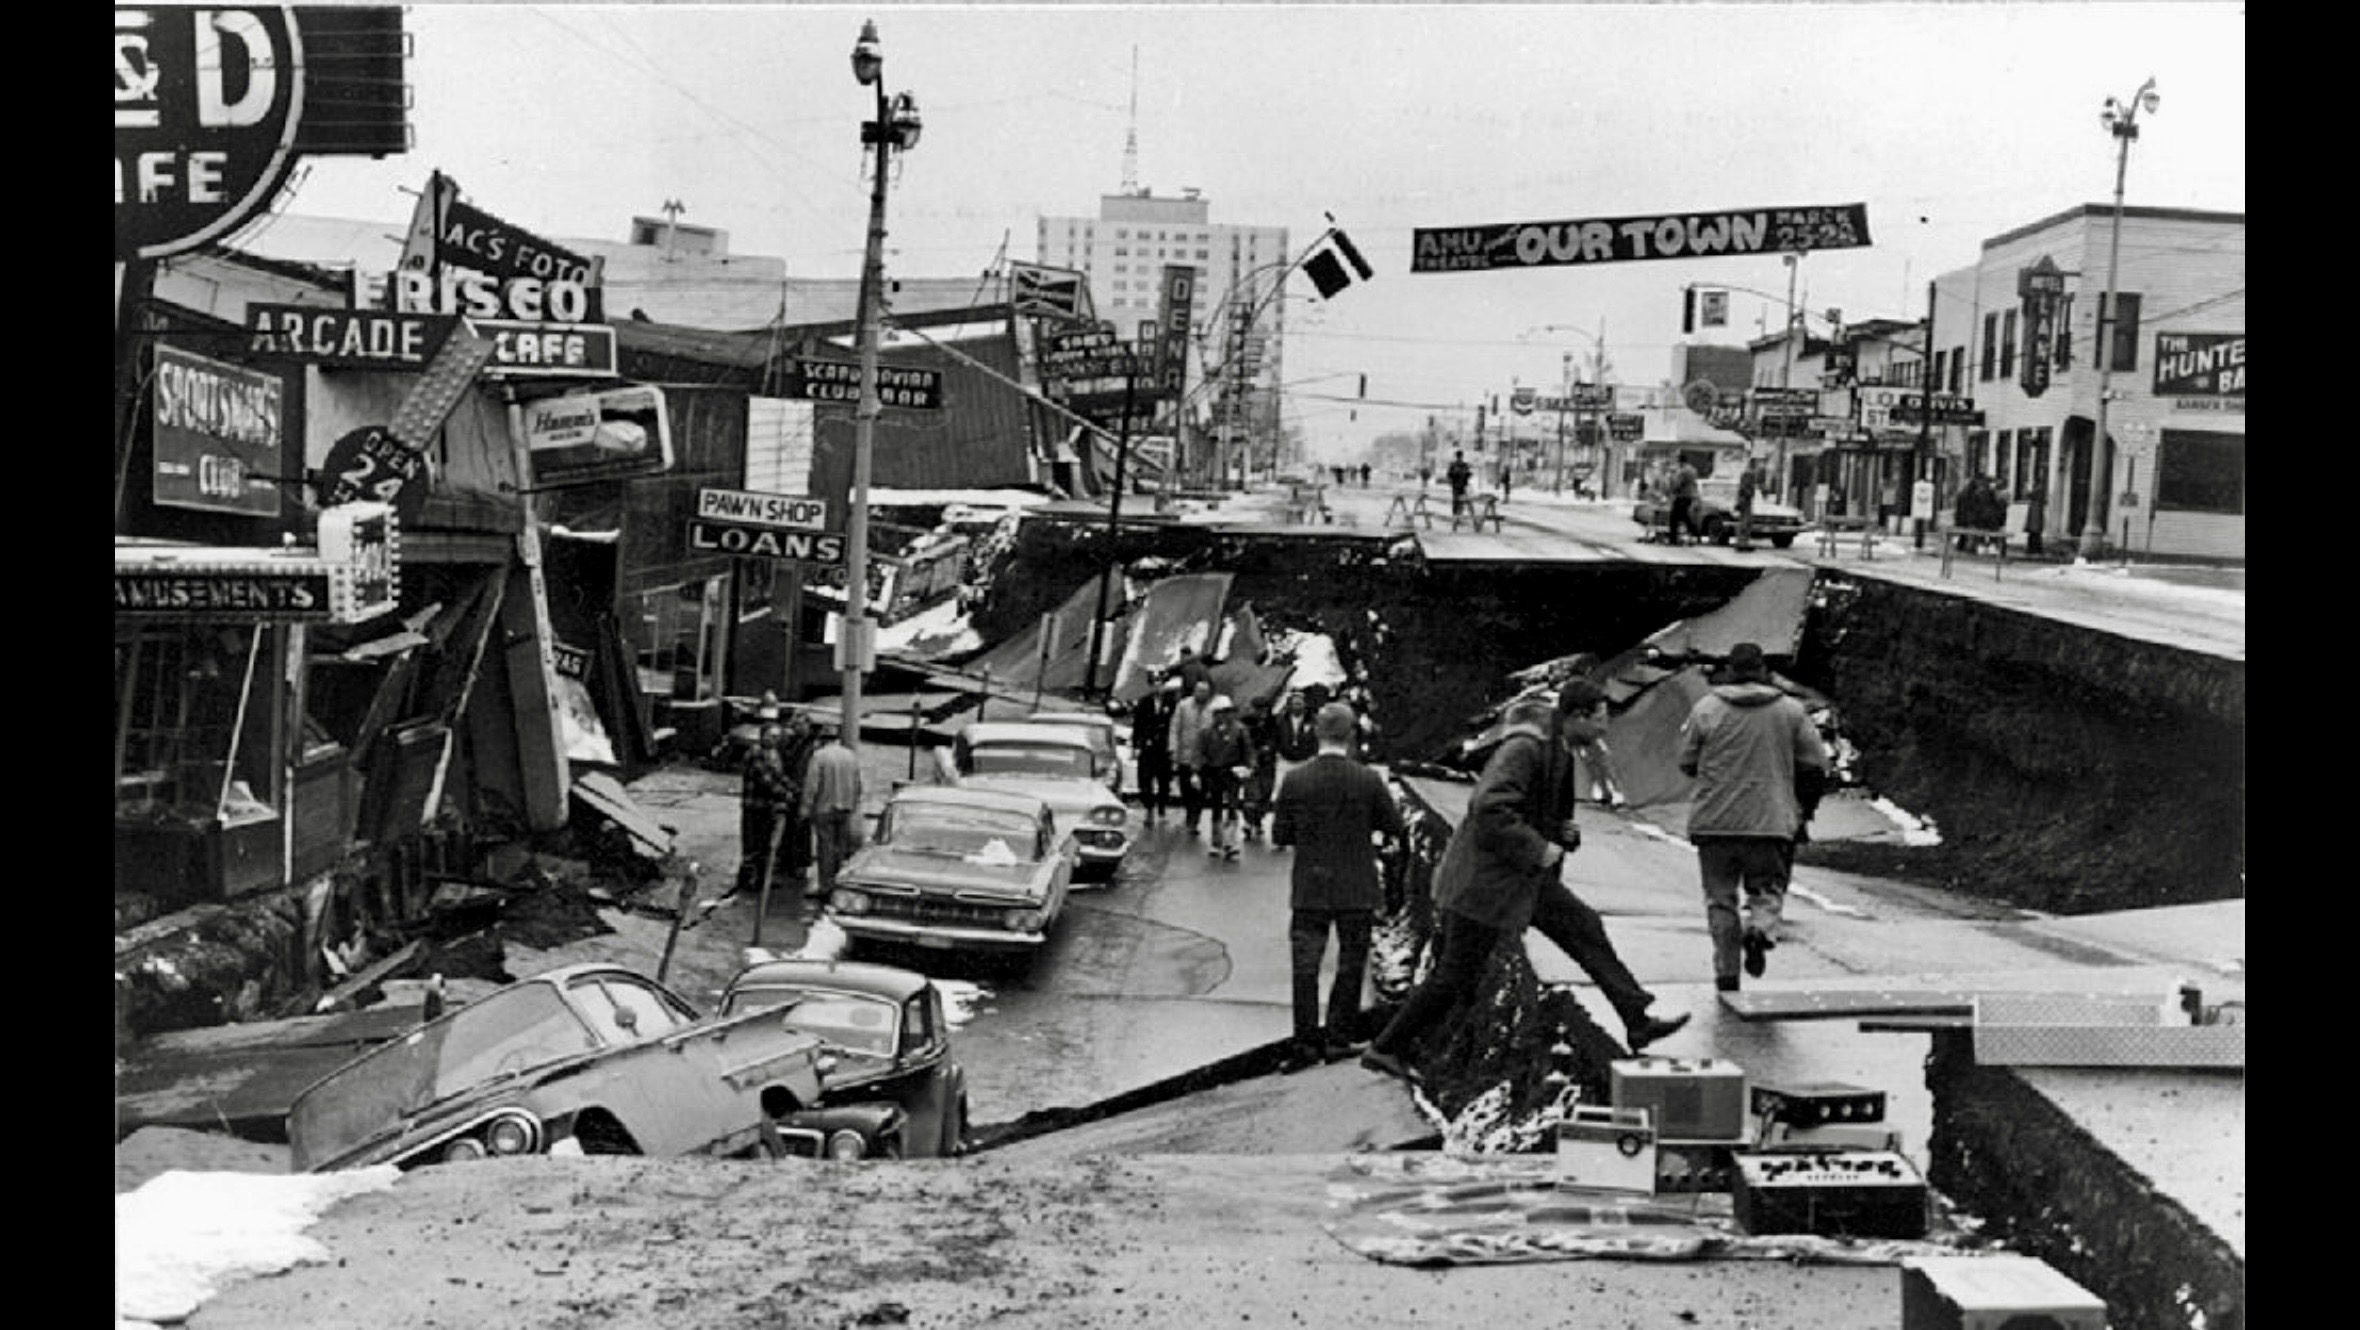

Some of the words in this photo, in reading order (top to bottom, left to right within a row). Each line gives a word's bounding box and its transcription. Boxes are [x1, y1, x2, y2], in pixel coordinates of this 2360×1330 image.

[195, 10, 276, 127] D
[1515, 221, 1613, 264] OUR
[1619, 212, 1768, 257] TOWN
[252, 312, 424, 363] ARCADE
[496, 331, 586, 364] CAFE
[340, 453, 404, 503] 24
[704, 491, 763, 518] PAWN
[766, 499, 822, 524] SHOP
[692, 525, 841, 561] LOANS
